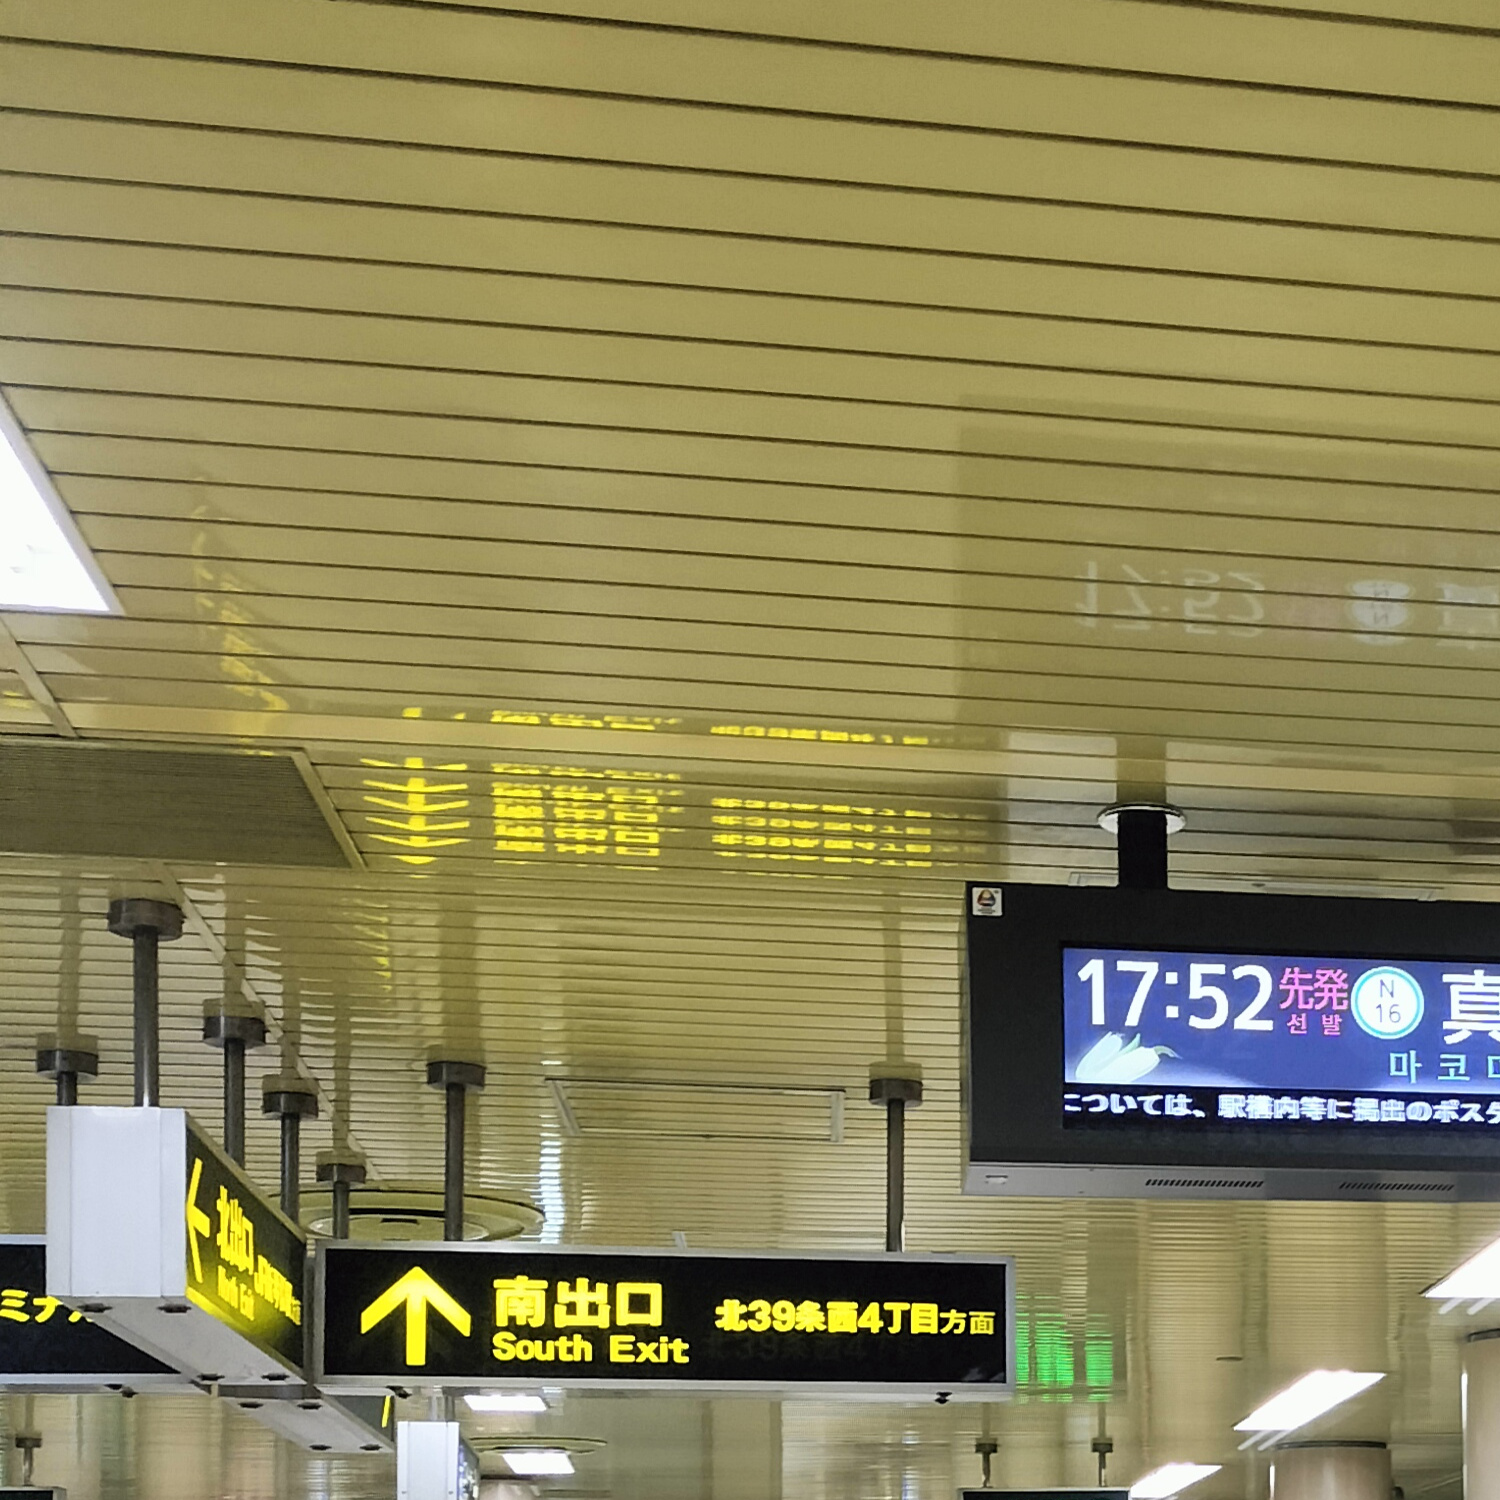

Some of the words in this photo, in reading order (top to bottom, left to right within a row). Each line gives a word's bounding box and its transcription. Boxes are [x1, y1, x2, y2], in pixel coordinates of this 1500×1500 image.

[1077, 958, 1275, 1032] 17:52
[1279, 967, 1349, 1011] 先発
[1378, 978, 1395, 998] N
[1375, 1003, 1402, 1025] 16
[492, 1275, 663, 1330] 南出口
[492, 1331, 594, 1363] South
[609, 1334, 690, 1364] Exit
